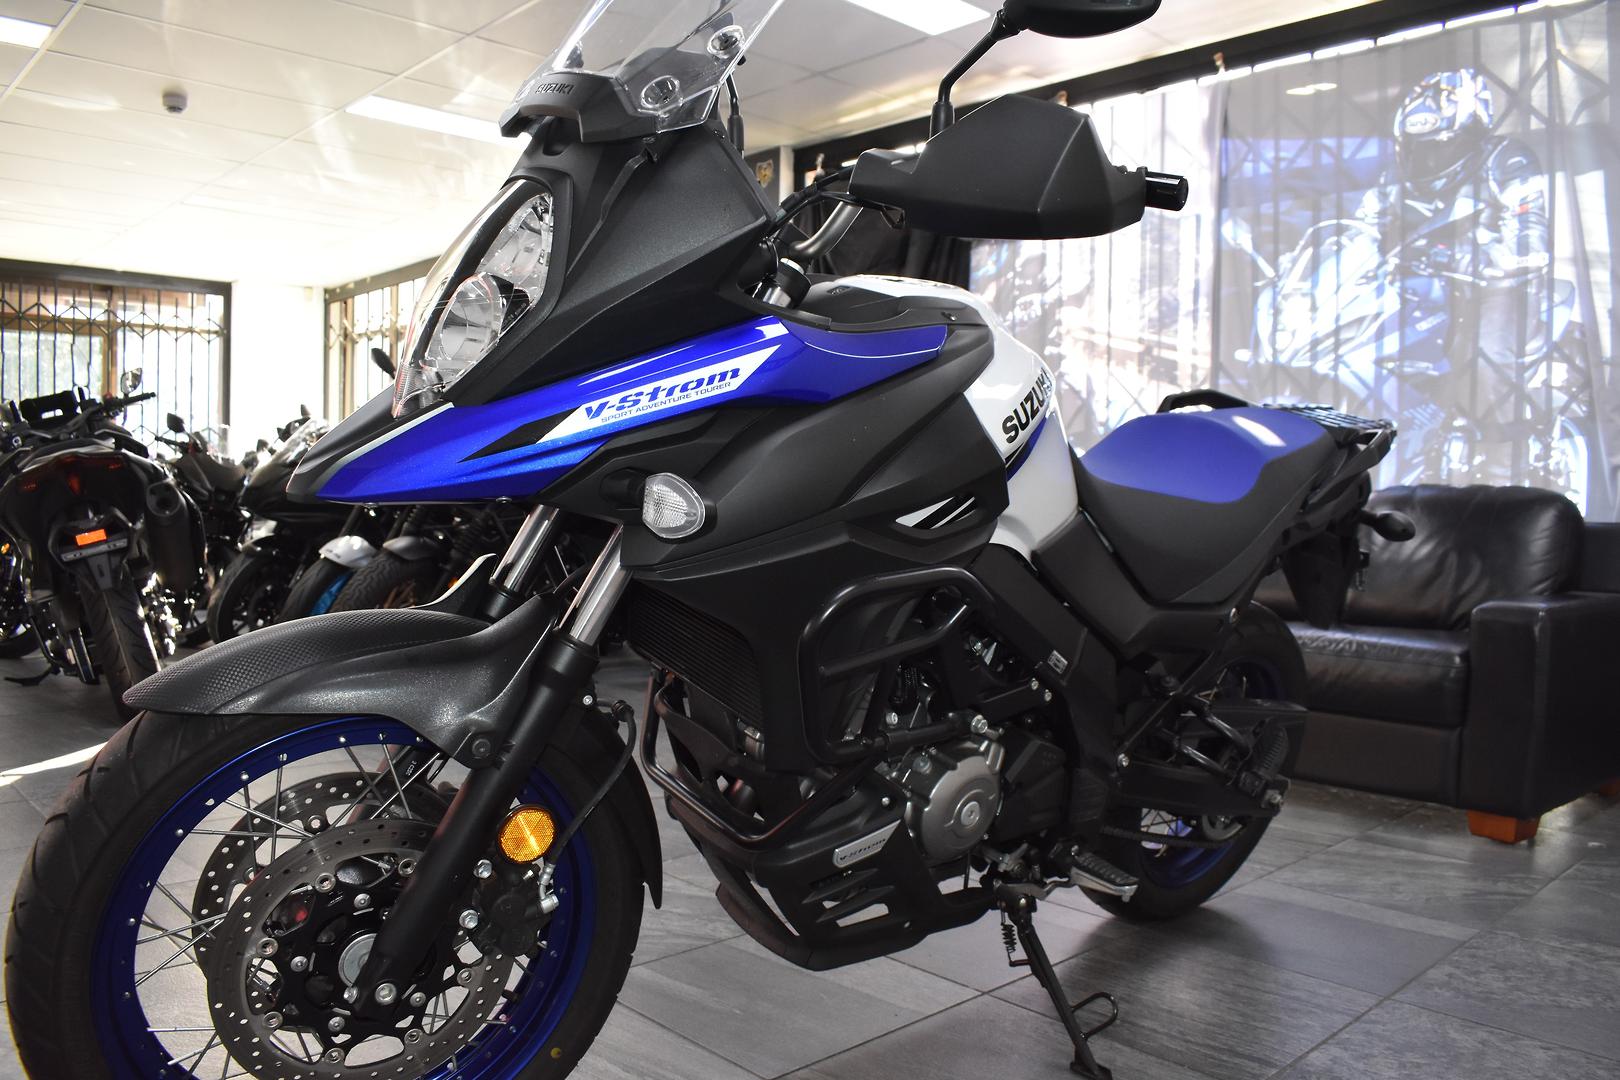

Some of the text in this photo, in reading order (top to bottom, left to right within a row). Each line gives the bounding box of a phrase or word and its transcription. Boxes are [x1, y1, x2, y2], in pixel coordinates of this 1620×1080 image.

[535, 82, 574, 95] SUZUKI
[585, 367, 741, 420] V-Strom
[601, 382, 731, 422] SPORT ADVENTURE TOURER
